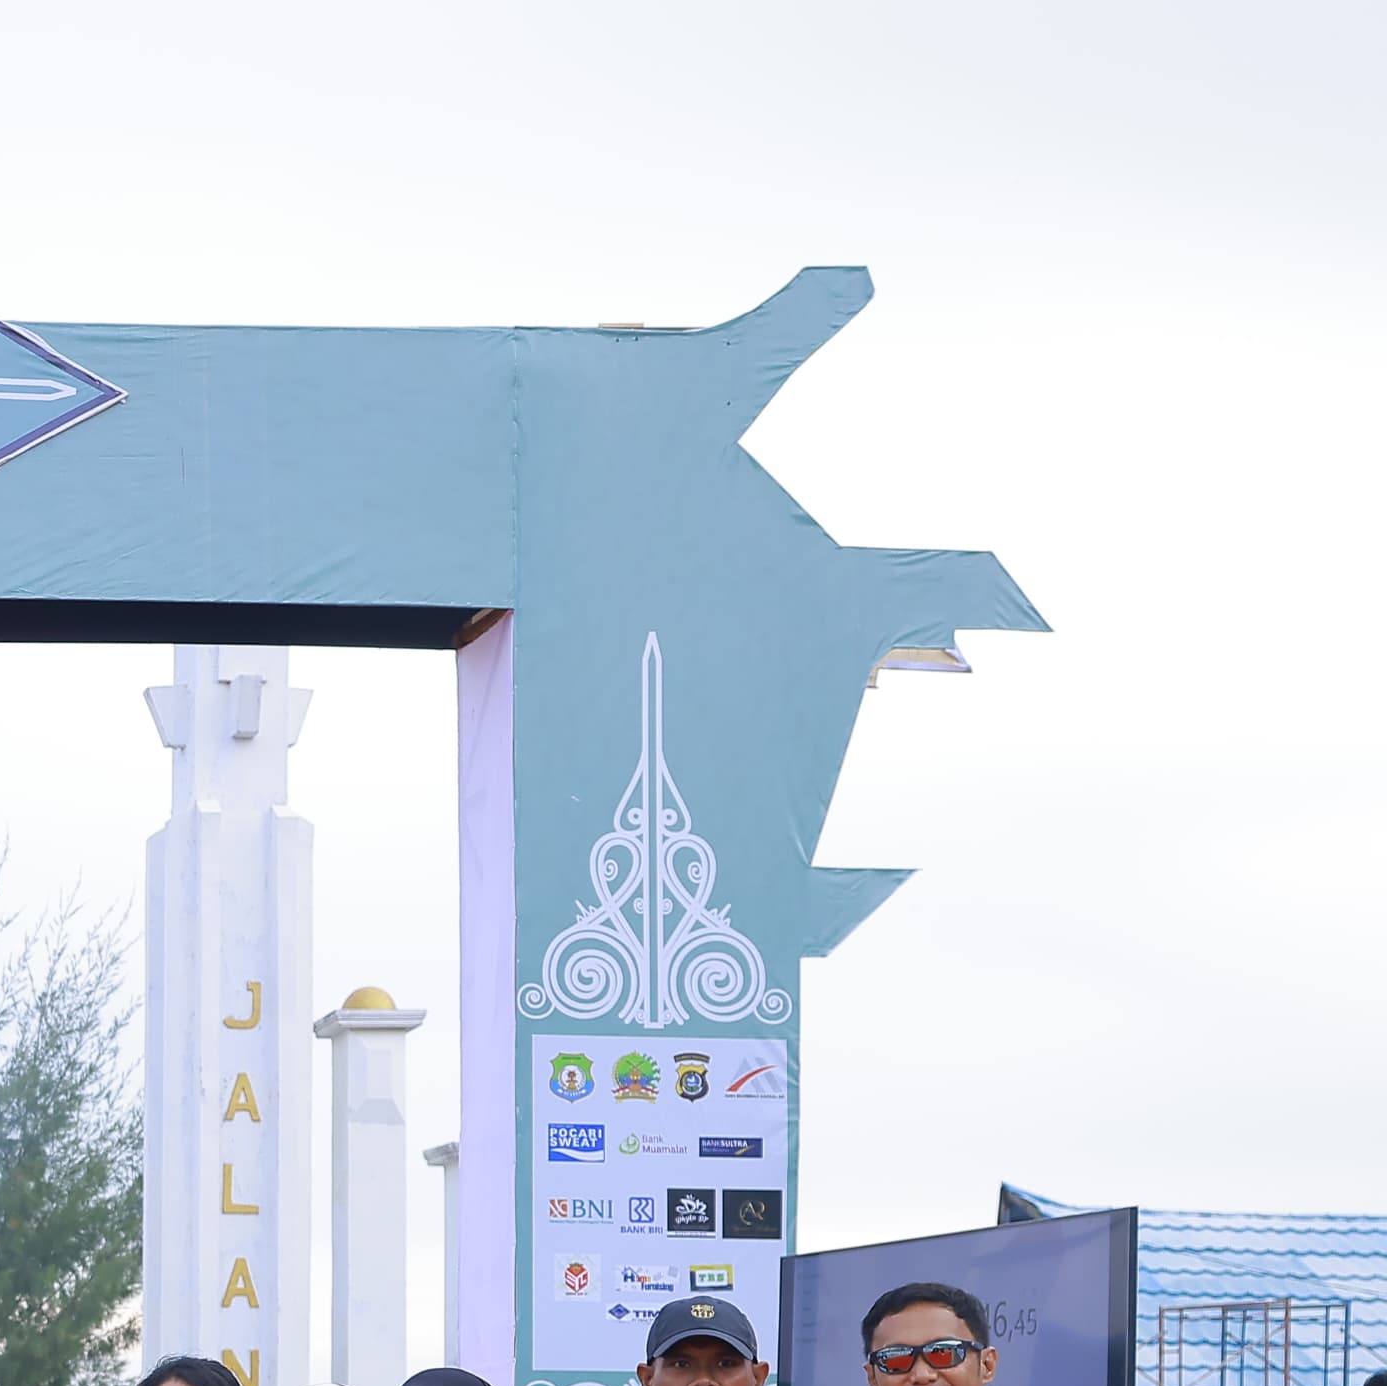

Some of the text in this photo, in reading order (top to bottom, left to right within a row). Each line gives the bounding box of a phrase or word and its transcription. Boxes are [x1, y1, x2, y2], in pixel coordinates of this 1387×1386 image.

[550, 1127, 603, 1138] POCARI
[550, 1138, 598, 1147] SWEAT
[642, 1134, 664, 1143] Bank
[642, 1145, 688, 1153] Muamalat
[572, 1199, 613, 1219] BNI
[620, 1226, 664, 1234] BANK BRI
[698, 1273, 725, 1282] TBS
[633, 1310, 660, 1318] TIM
